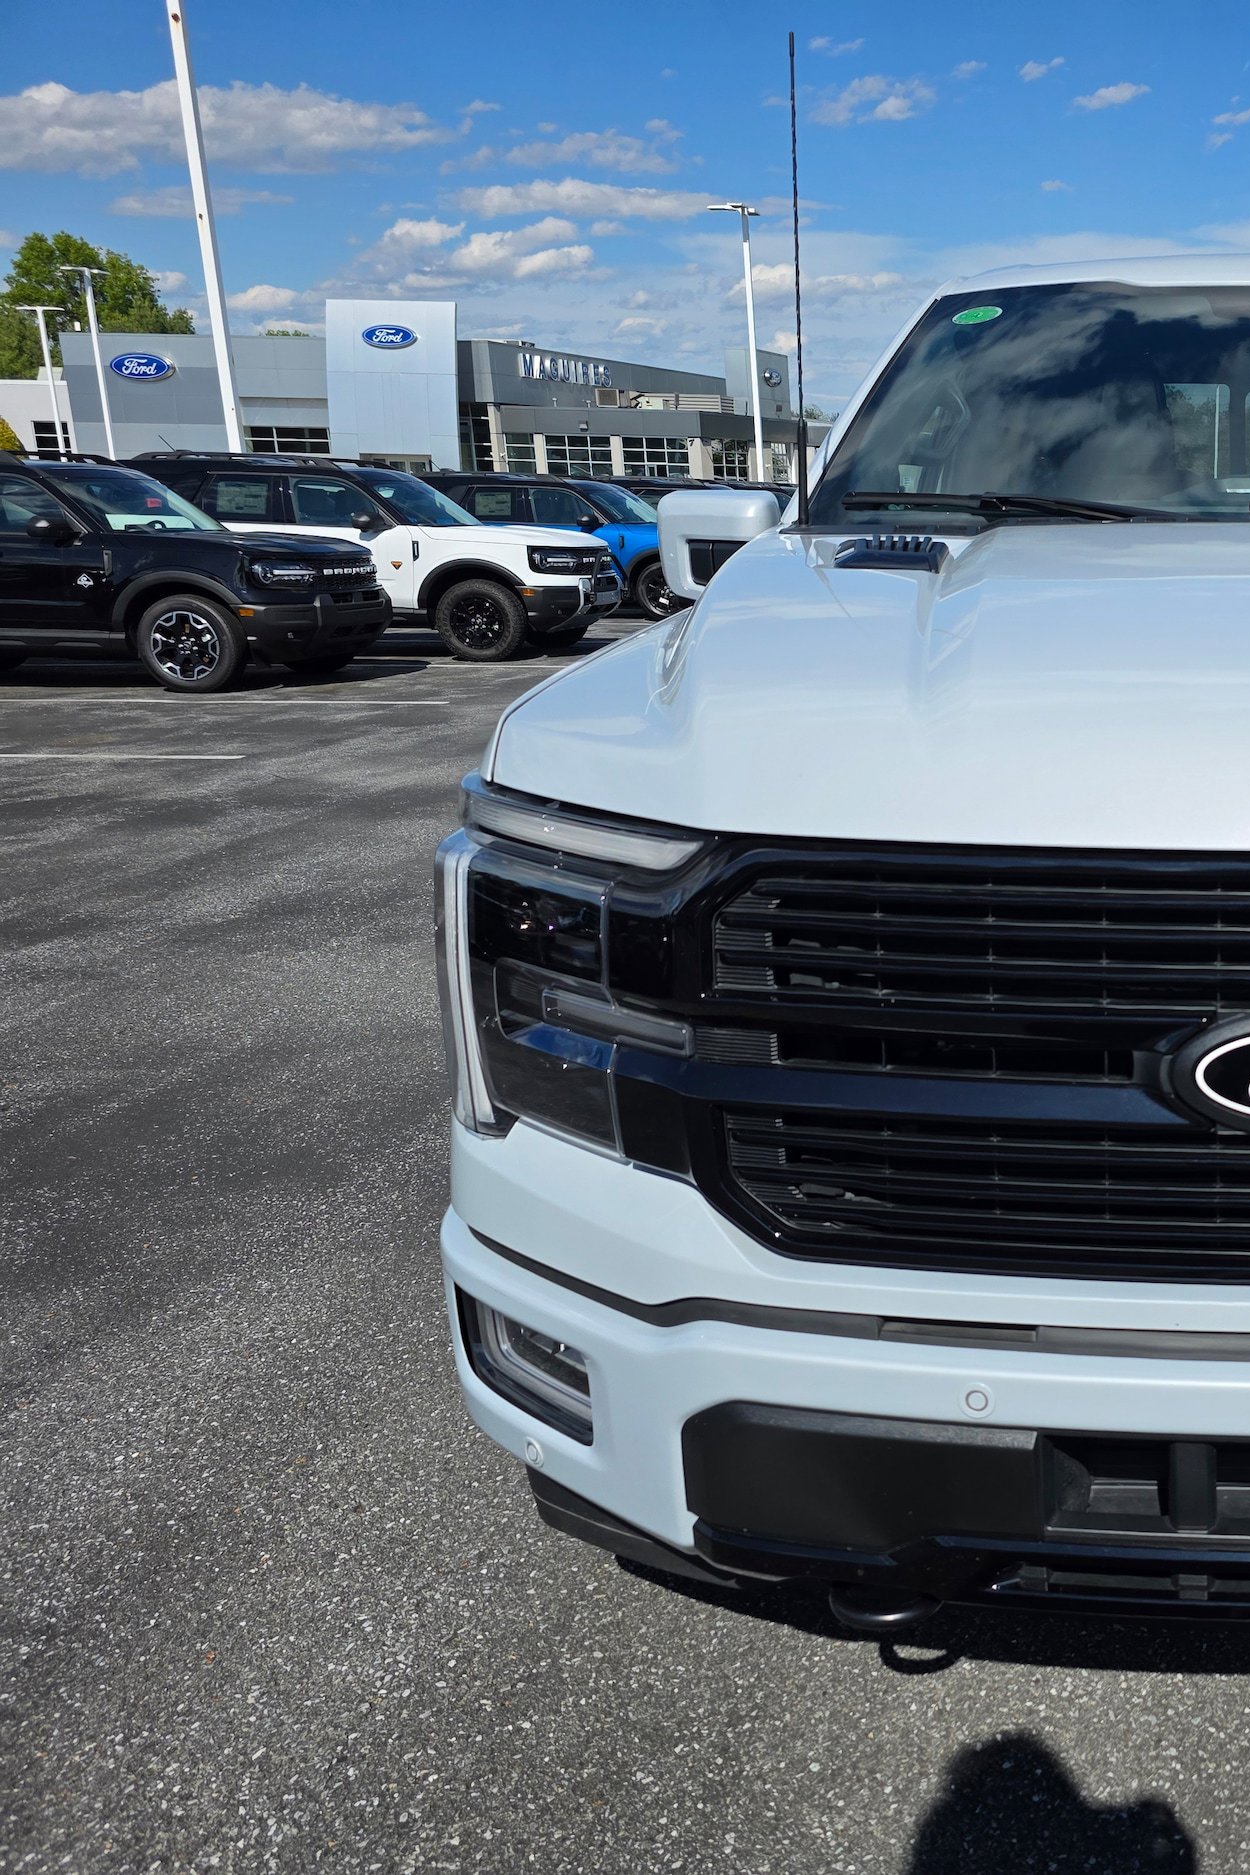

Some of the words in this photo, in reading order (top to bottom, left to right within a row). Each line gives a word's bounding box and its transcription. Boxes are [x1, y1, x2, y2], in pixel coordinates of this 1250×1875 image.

[372, 328, 404, 343] Ford
[121, 357, 157, 375] Ford
[519, 352, 612, 388] MAGUIRES
[323, 563, 378, 576] BRONCO
